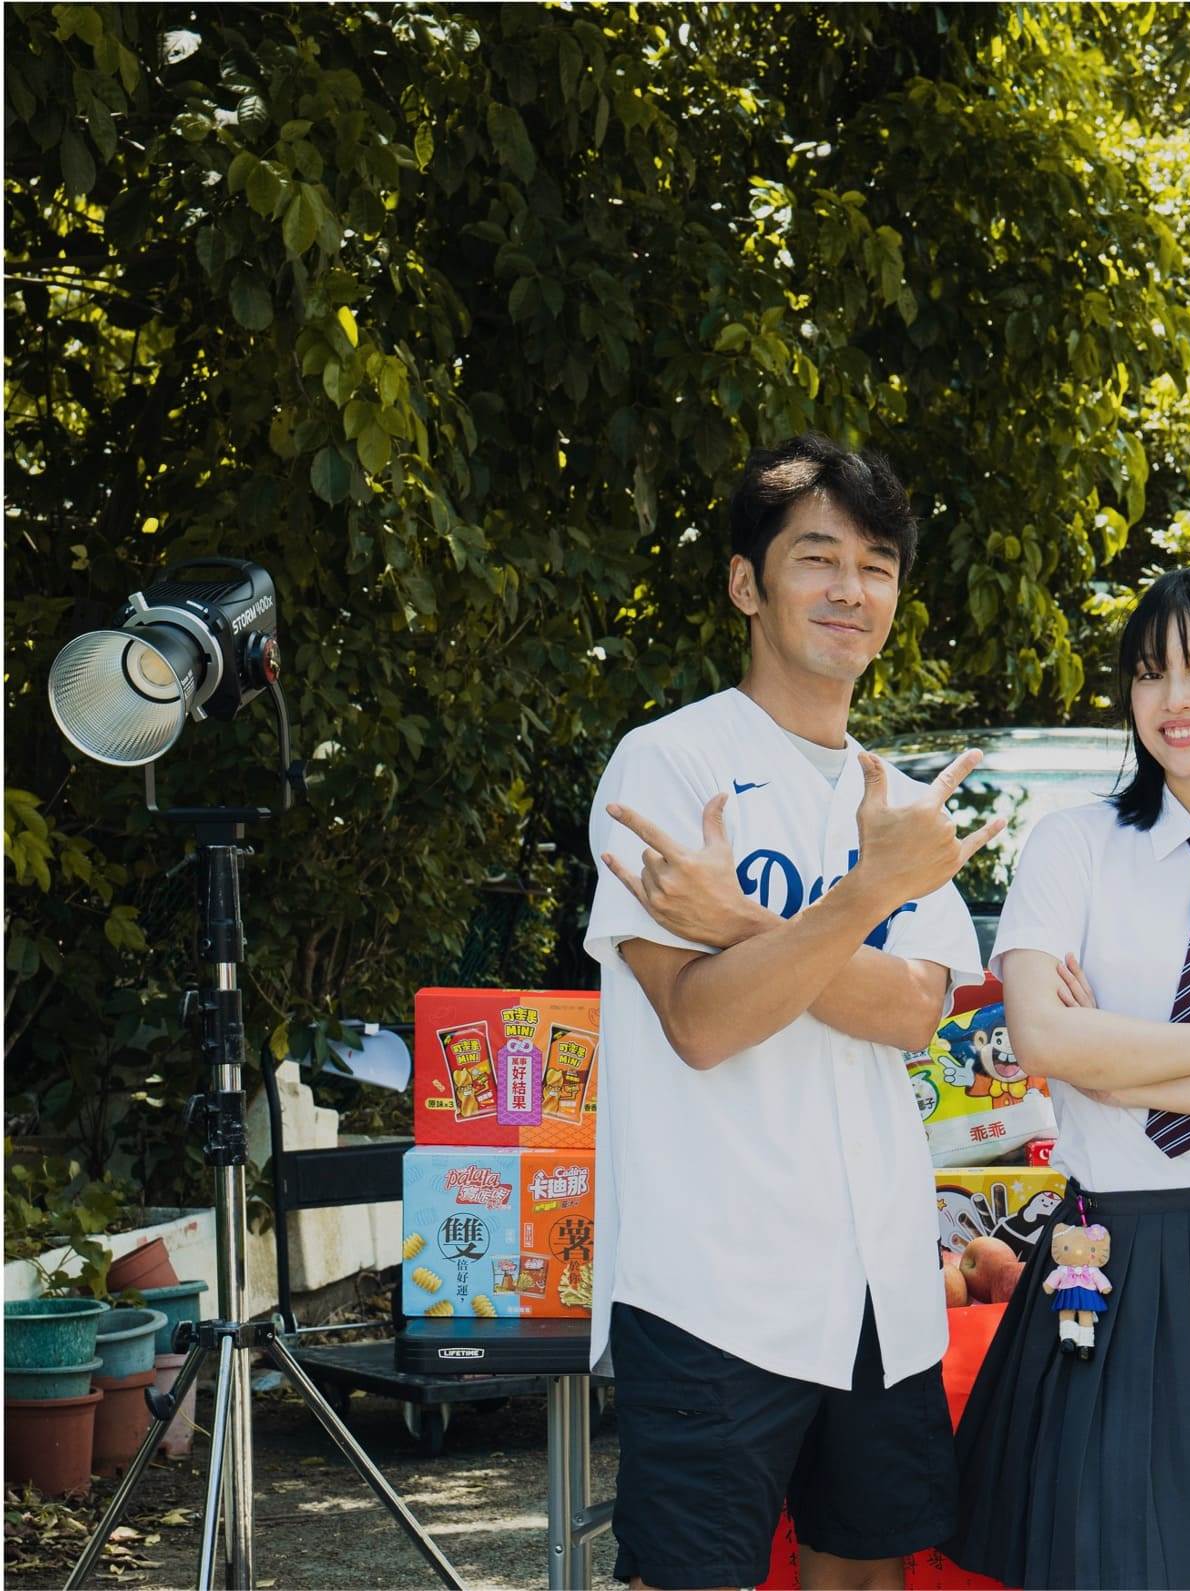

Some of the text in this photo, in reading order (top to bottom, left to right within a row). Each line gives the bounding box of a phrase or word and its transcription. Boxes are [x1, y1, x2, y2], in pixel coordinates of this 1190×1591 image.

[232, 606, 257, 635] STORM
[512, 1066, 526, 1109] 好結果
[969, 1121, 1006, 1141] 乖乖
[529, 1171, 588, 1200] 卡迪那
